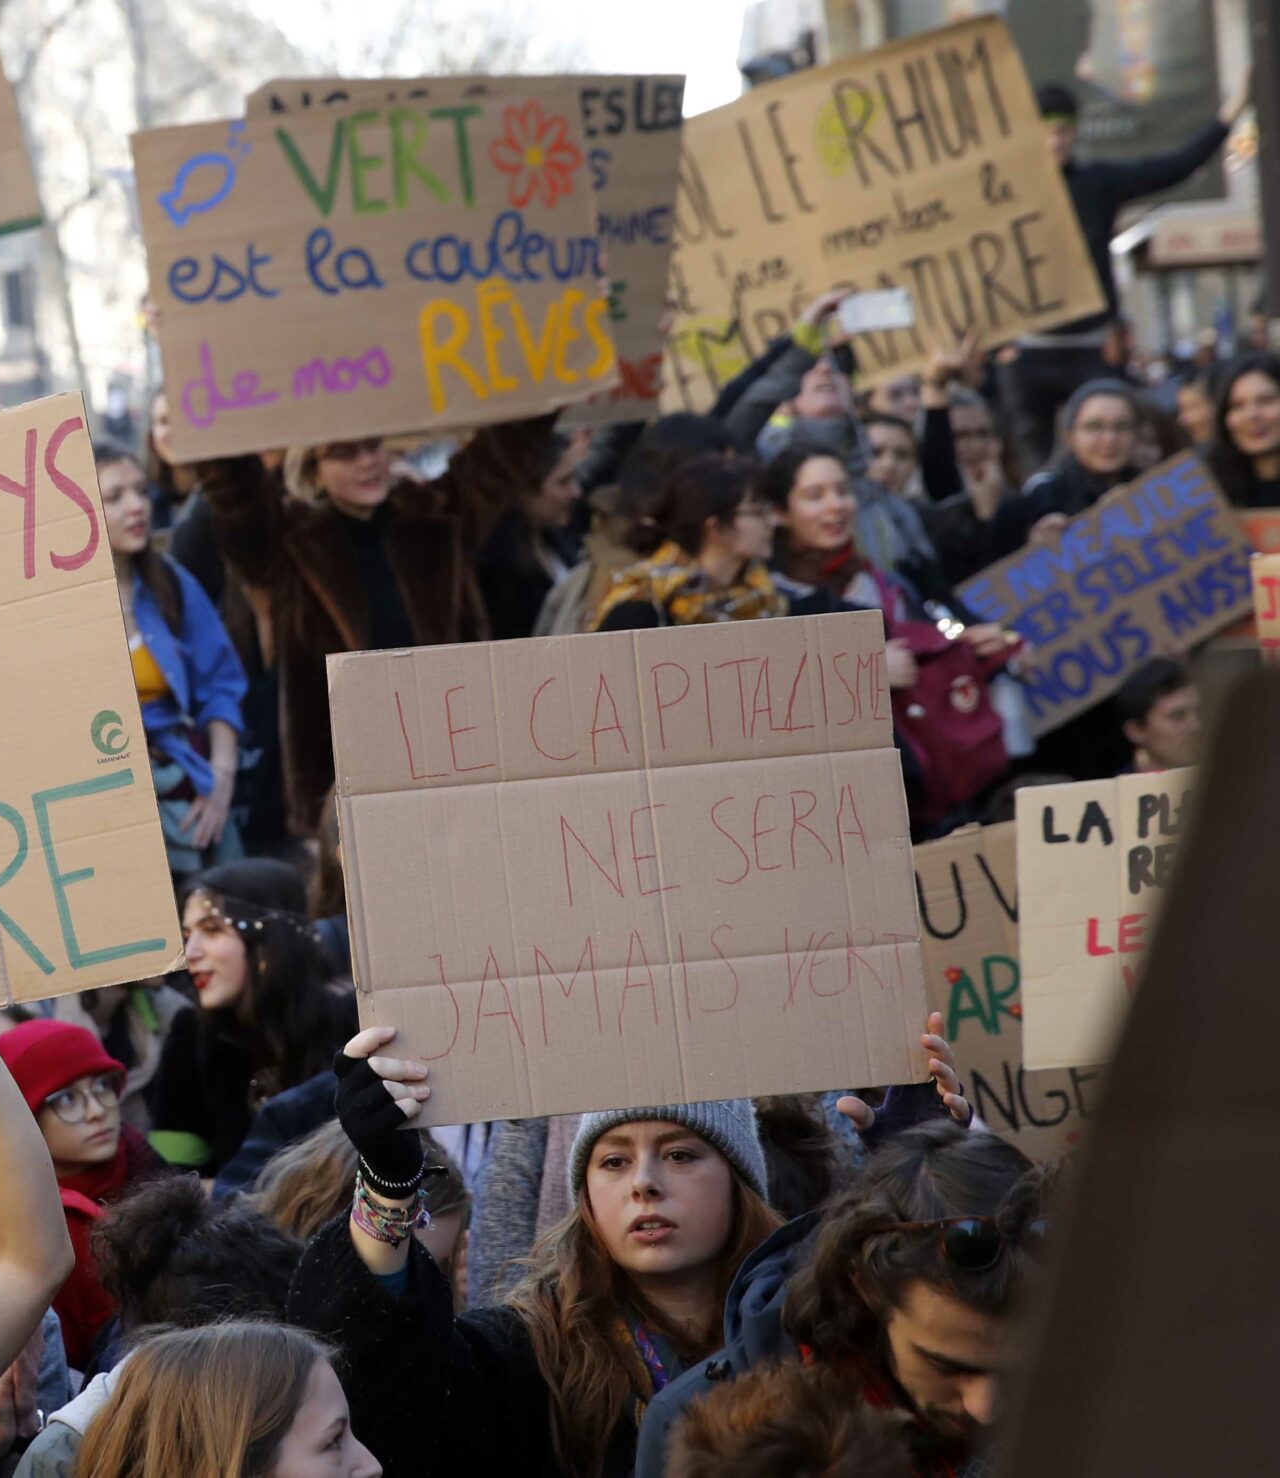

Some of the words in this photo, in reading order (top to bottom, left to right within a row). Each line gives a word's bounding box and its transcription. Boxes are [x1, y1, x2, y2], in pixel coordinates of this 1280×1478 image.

[274, 102, 483, 217] VERT
[736, 101, 815, 223] LE
[832, 36, 1012, 188] RHUM
[168, 244, 281, 303] est
[305, 226, 385, 295] la
[405, 209, 604, 284] couleur
[182, 340, 281, 429] de
[418, 276, 618, 415] RÊVES
[1024, 609, 1151, 719] NOUS
[1157, 542, 1254, 638] AUSS
[394, 685, 496, 781] LE
[528, 650, 888, 765] CAPITALISME
[560, 802, 681, 907] NE
[710, 783, 871, 885] SERA
[1042, 800, 1114, 846] LA
[420, 923, 740, 1062] JAMAIS
[782, 926, 921, 1012] VERT
